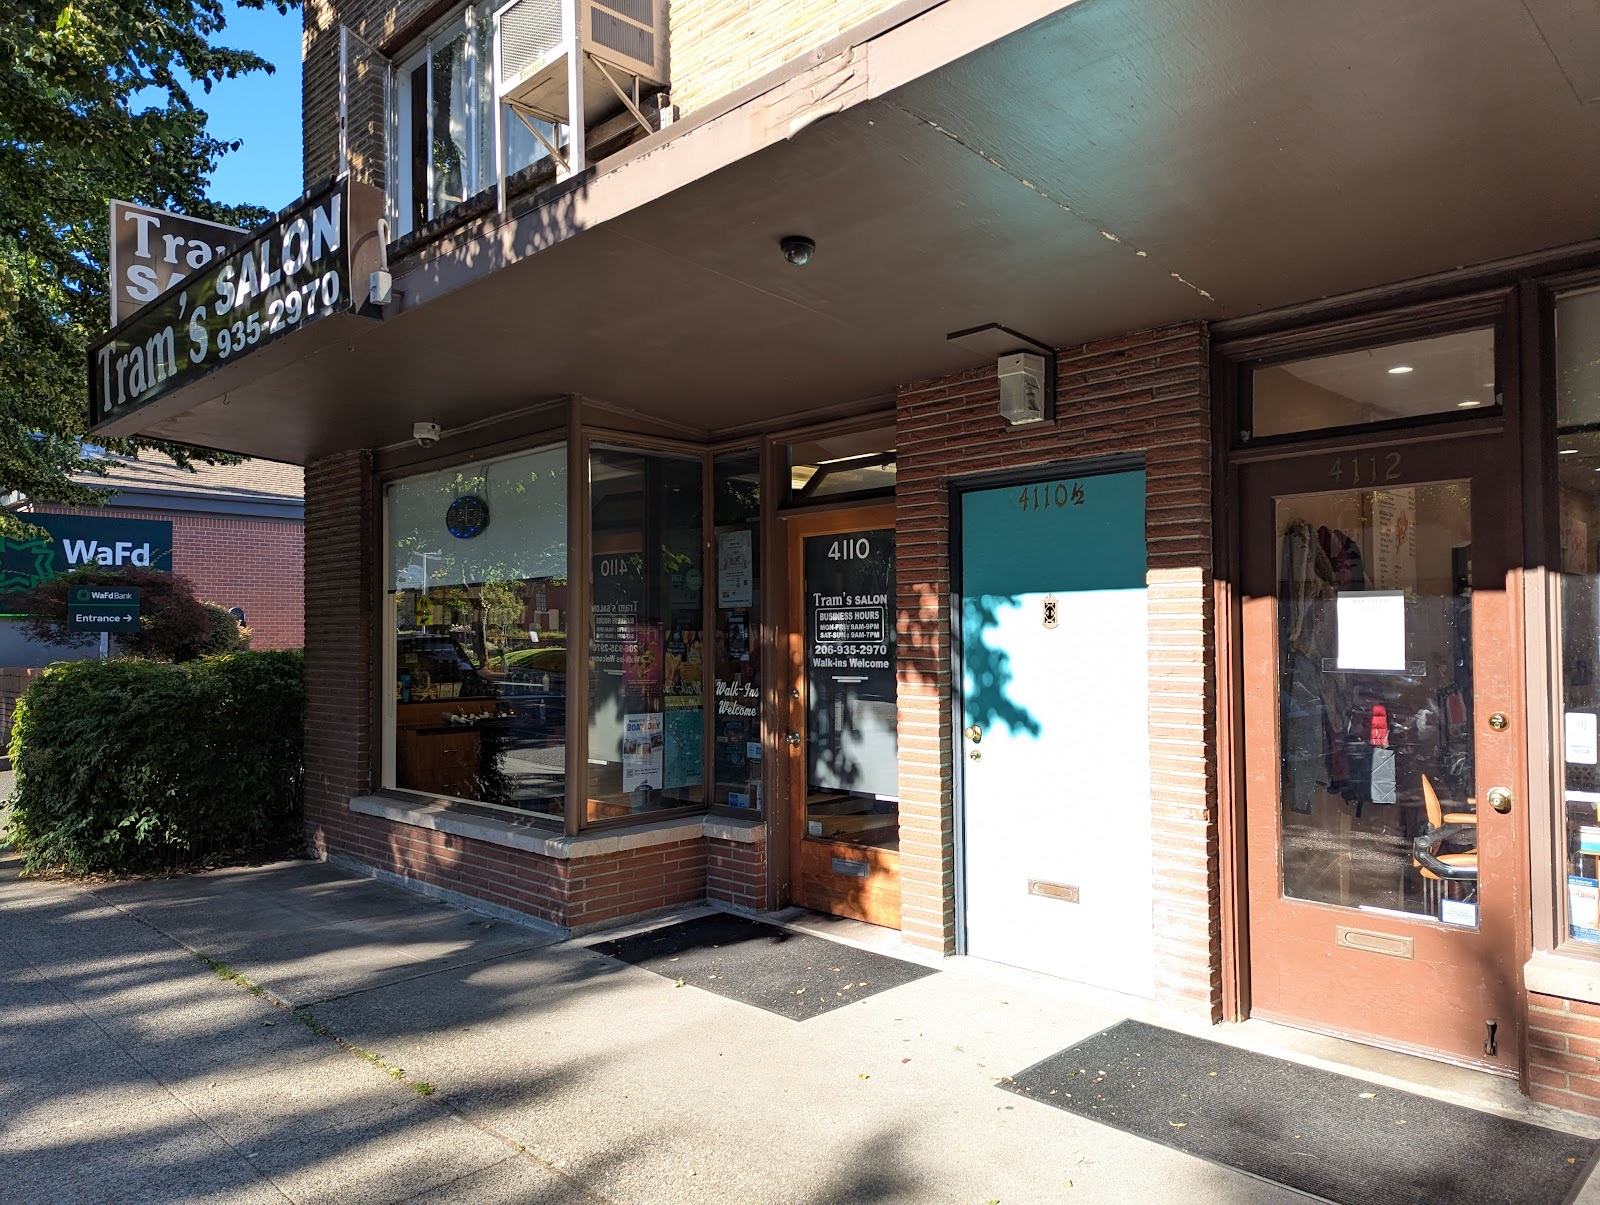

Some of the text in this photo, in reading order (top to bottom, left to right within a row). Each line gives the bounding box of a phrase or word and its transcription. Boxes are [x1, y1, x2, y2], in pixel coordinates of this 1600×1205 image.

[124, 211, 226, 270] Tra
[214, 193, 342, 316] SALON
[216, 269, 340, 360] 935-2970
[1328, 451, 1402, 486] 4112
[63, 538, 150, 567] WaFd
[828, 538, 870, 560] 4110
[813, 591, 888, 607] Tram's SALON
[75, 613, 121, 623] Entrance
[819, 611, 880, 621] BUSINESS HOURS
[815, 644, 887, 655] 206-935-2970
[813, 658, 890, 668] Walk-ins Welcome
[715, 681, 760, 698] Walk-Ins
[718, 700, 757, 717] Welcome
